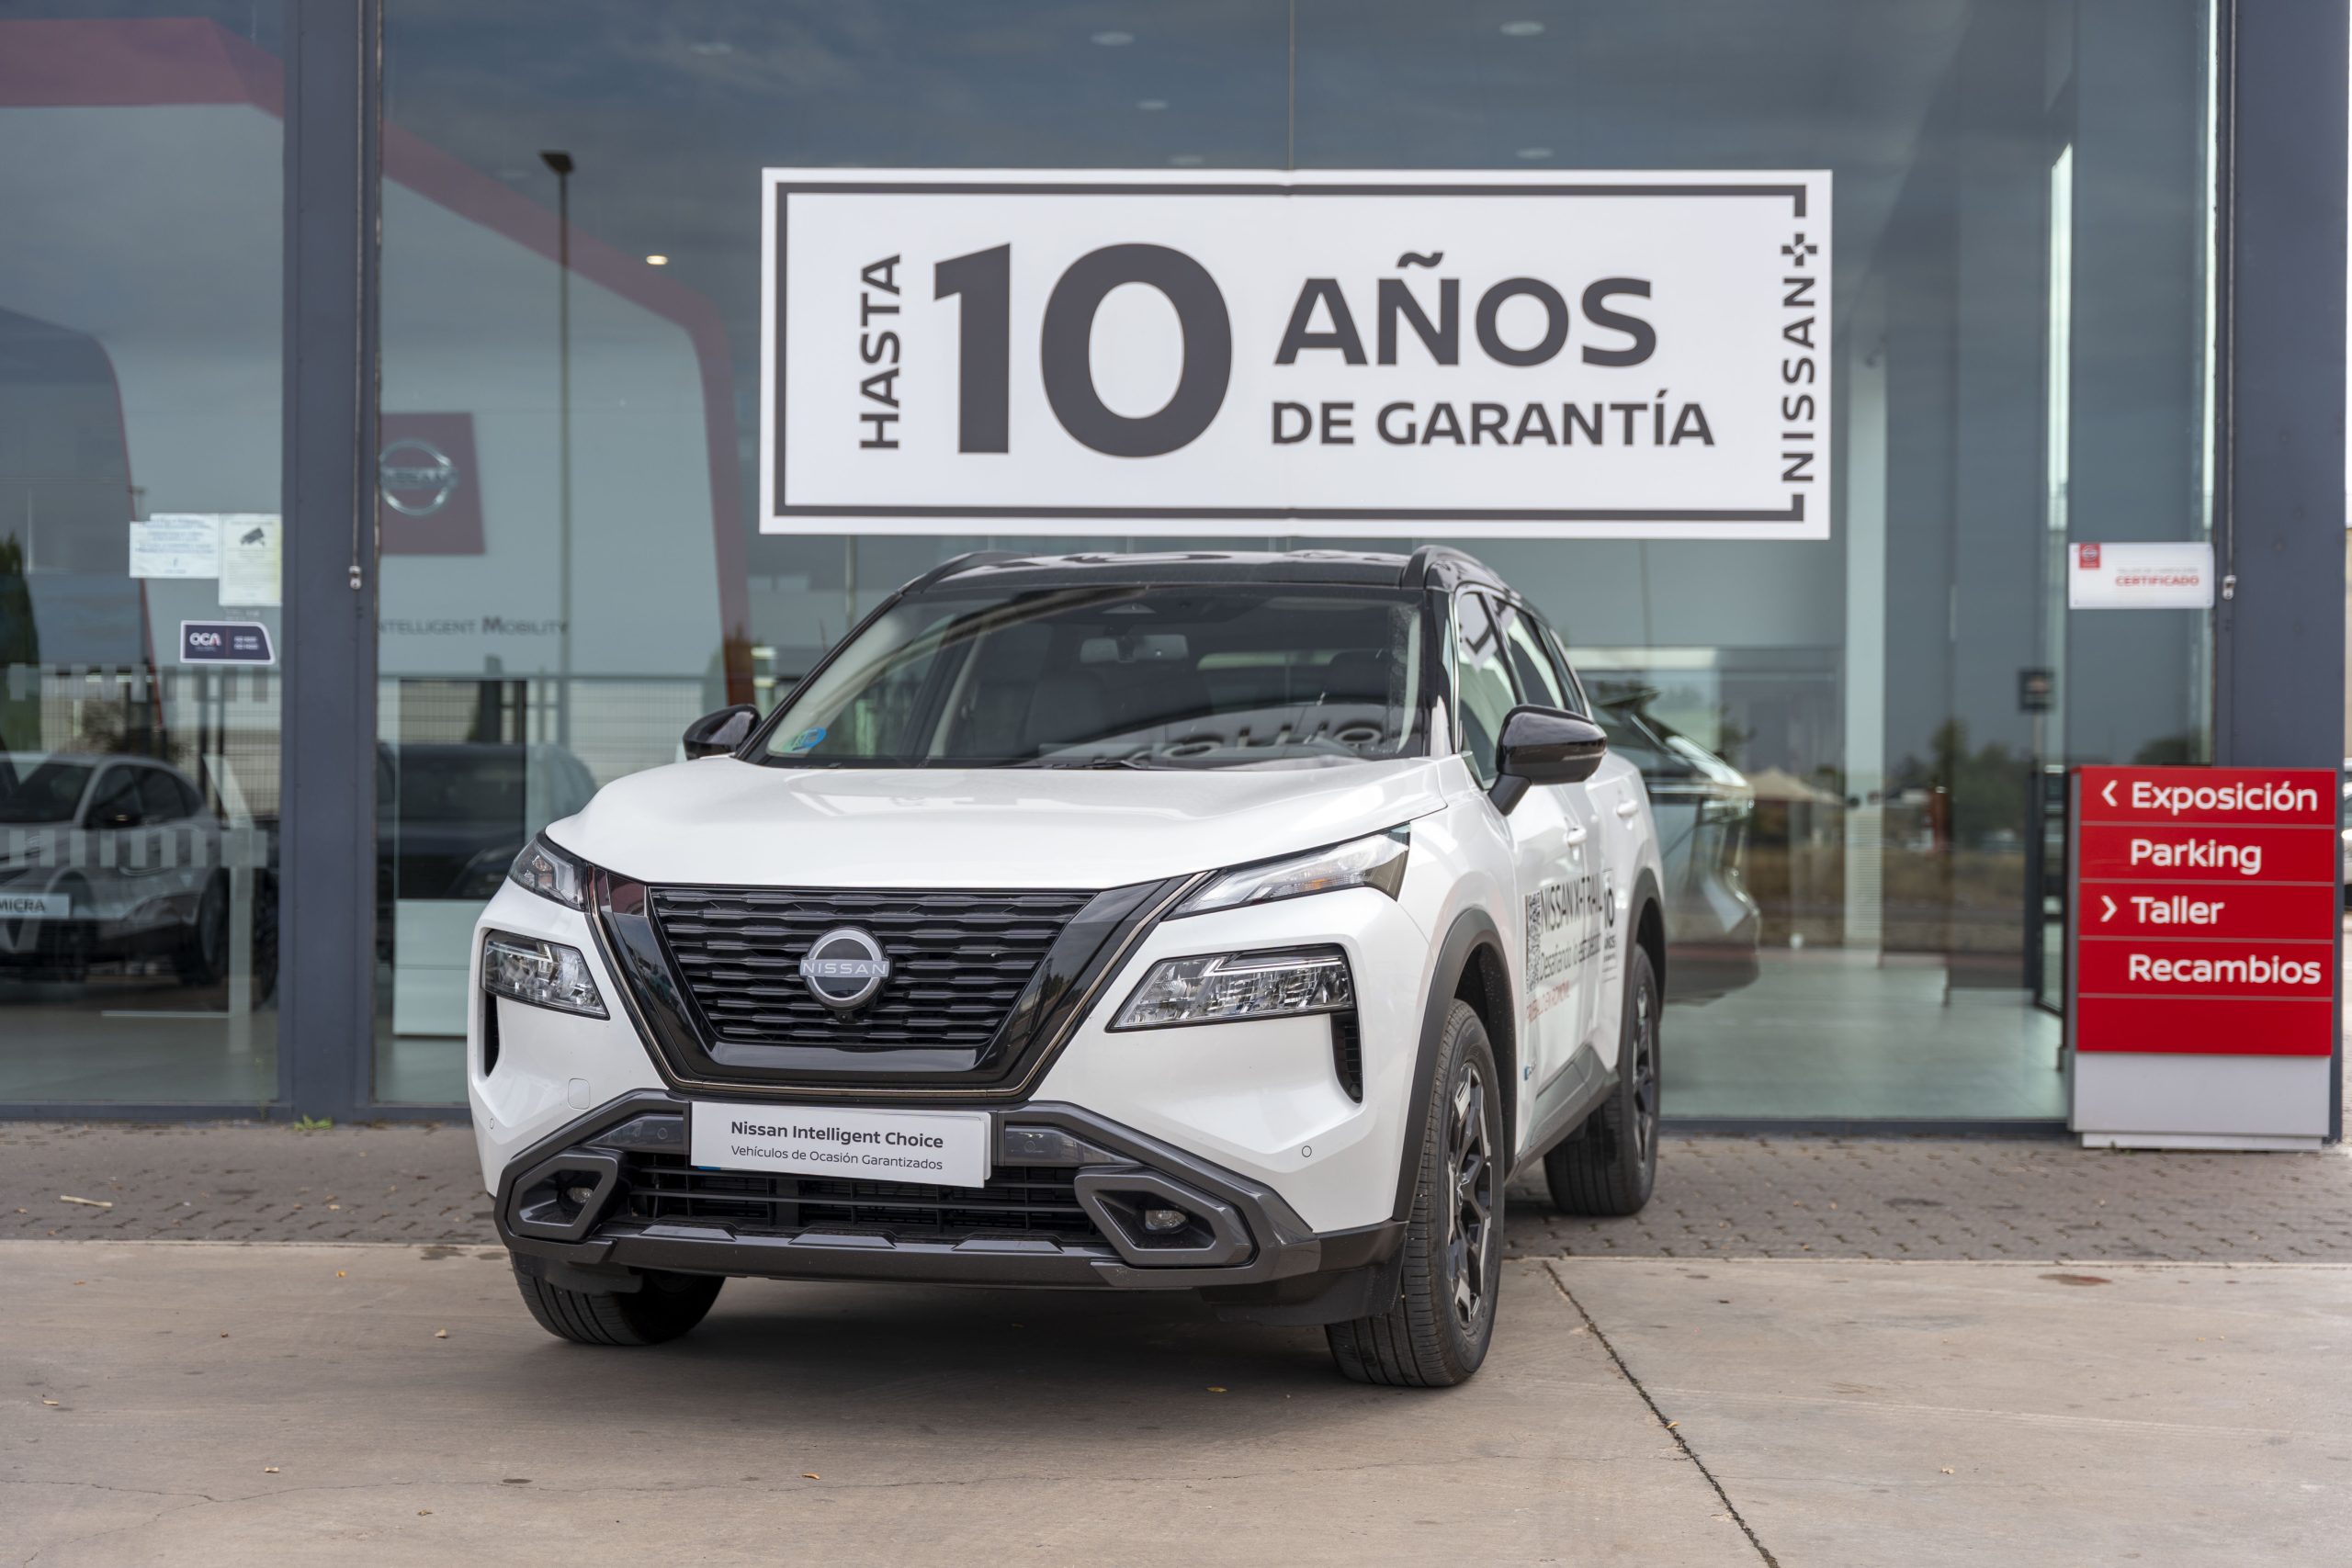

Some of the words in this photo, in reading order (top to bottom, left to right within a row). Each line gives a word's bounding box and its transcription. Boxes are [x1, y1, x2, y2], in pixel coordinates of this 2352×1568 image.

[1273, 252, 1657, 367] AÑOS
[859, 254, 900, 449] HASTA
[933, 243, 1233, 458] 10
[1781, 277, 1815, 482] NISSAN
[1272, 401, 1354, 445] DE
[1376, 389, 1715, 446] GARANTÍA
[2115, 574, 2200, 588] CERTIFICADO
[2132, 781, 2318, 817] Exposición
[2131, 838, 2262, 875] Parking
[1540, 882, 1573, 934] NISSAN
[2130, 895, 2225, 925] Taller
[803, 963, 886, 975] NISSAN
[2129, 953, 2322, 985] Recambios
[730, 1121, 788, 1138] Nissan
[792, 1125, 881, 1145] Intelligent
[885, 1132, 944, 1148] Choice
[730, 1145, 788, 1159] Vehículos
[791, 1149, 807, 1160] de
[809, 1151, 858, 1164] Ocasión
[862, 1155, 944, 1170] Garantizados
